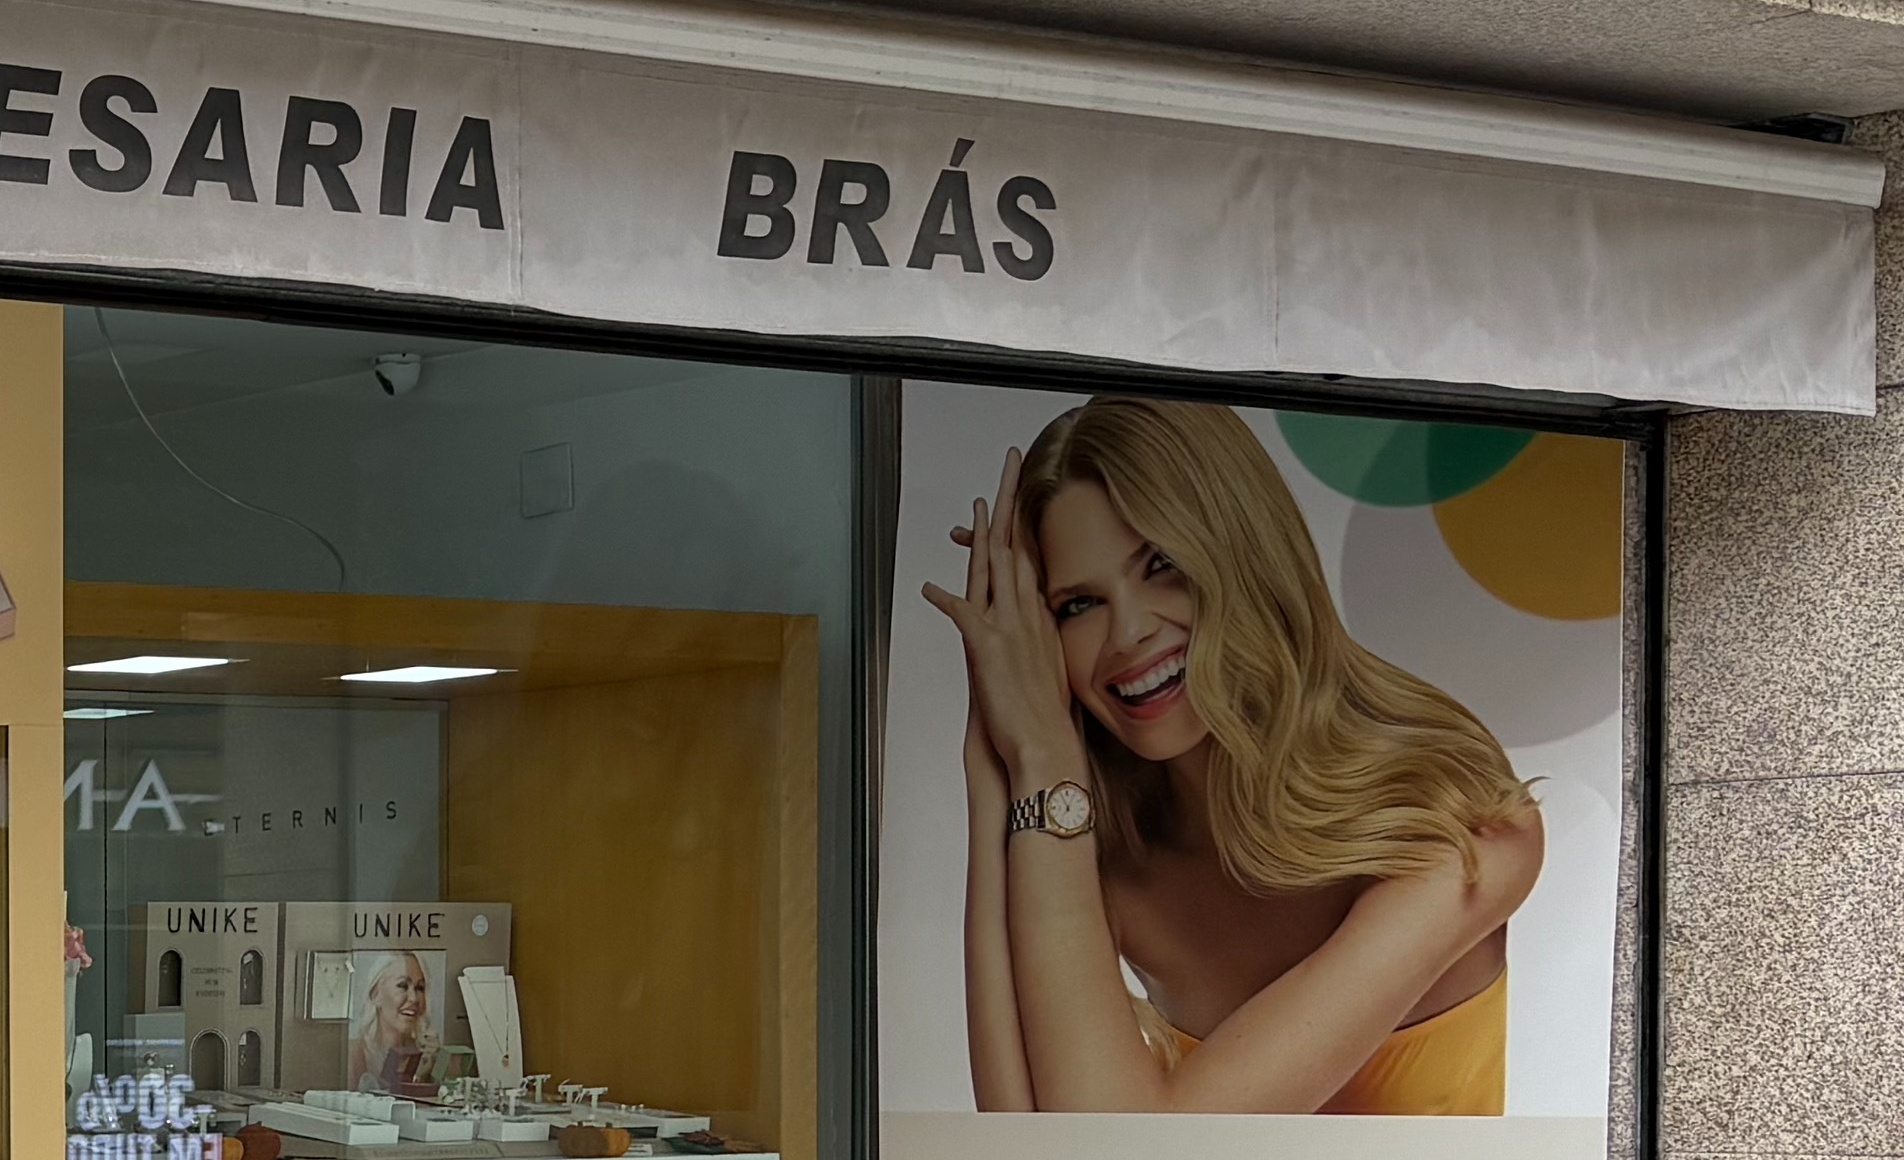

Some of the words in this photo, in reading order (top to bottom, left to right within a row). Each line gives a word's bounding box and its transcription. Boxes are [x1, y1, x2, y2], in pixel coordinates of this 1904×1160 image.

[717, 137, 1057, 281] BRÁS
[167, 907, 259, 935] UNIKE
[353, 912, 446, 939] UNIKE
